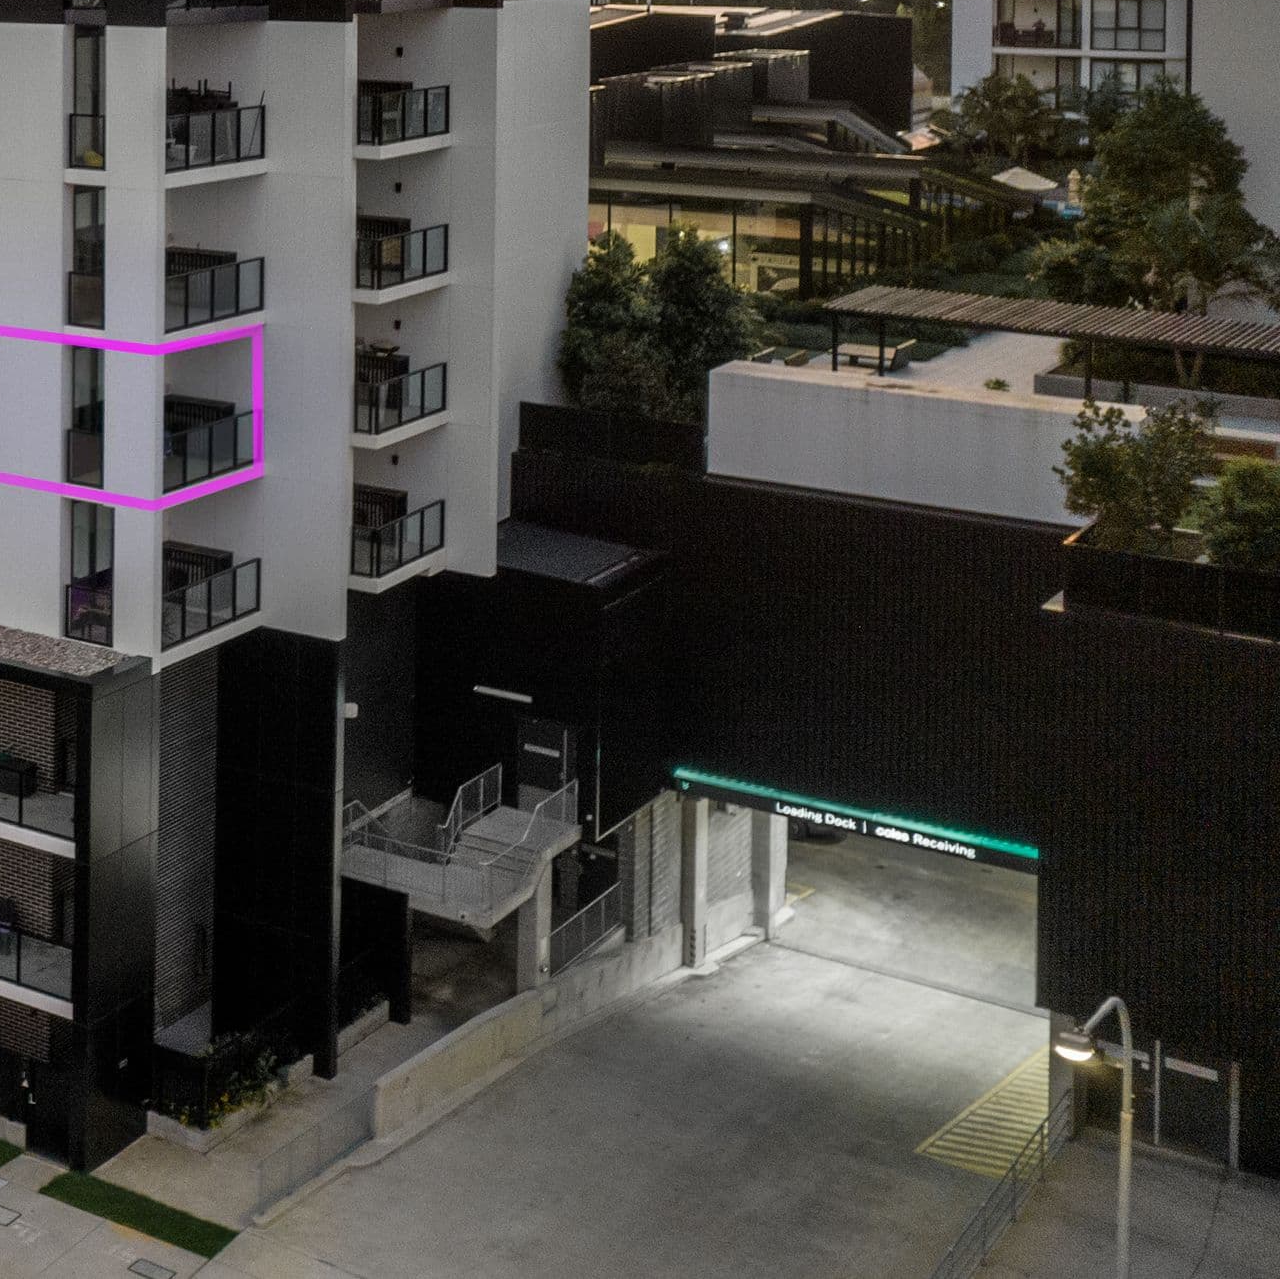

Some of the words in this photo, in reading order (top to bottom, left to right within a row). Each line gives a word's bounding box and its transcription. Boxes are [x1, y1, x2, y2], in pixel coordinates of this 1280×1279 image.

[776, 802, 822, 824] Loading
[824, 814, 857, 831] Dock
[875, 824, 910, 843] coles
[913, 833, 976, 860] Receiving
